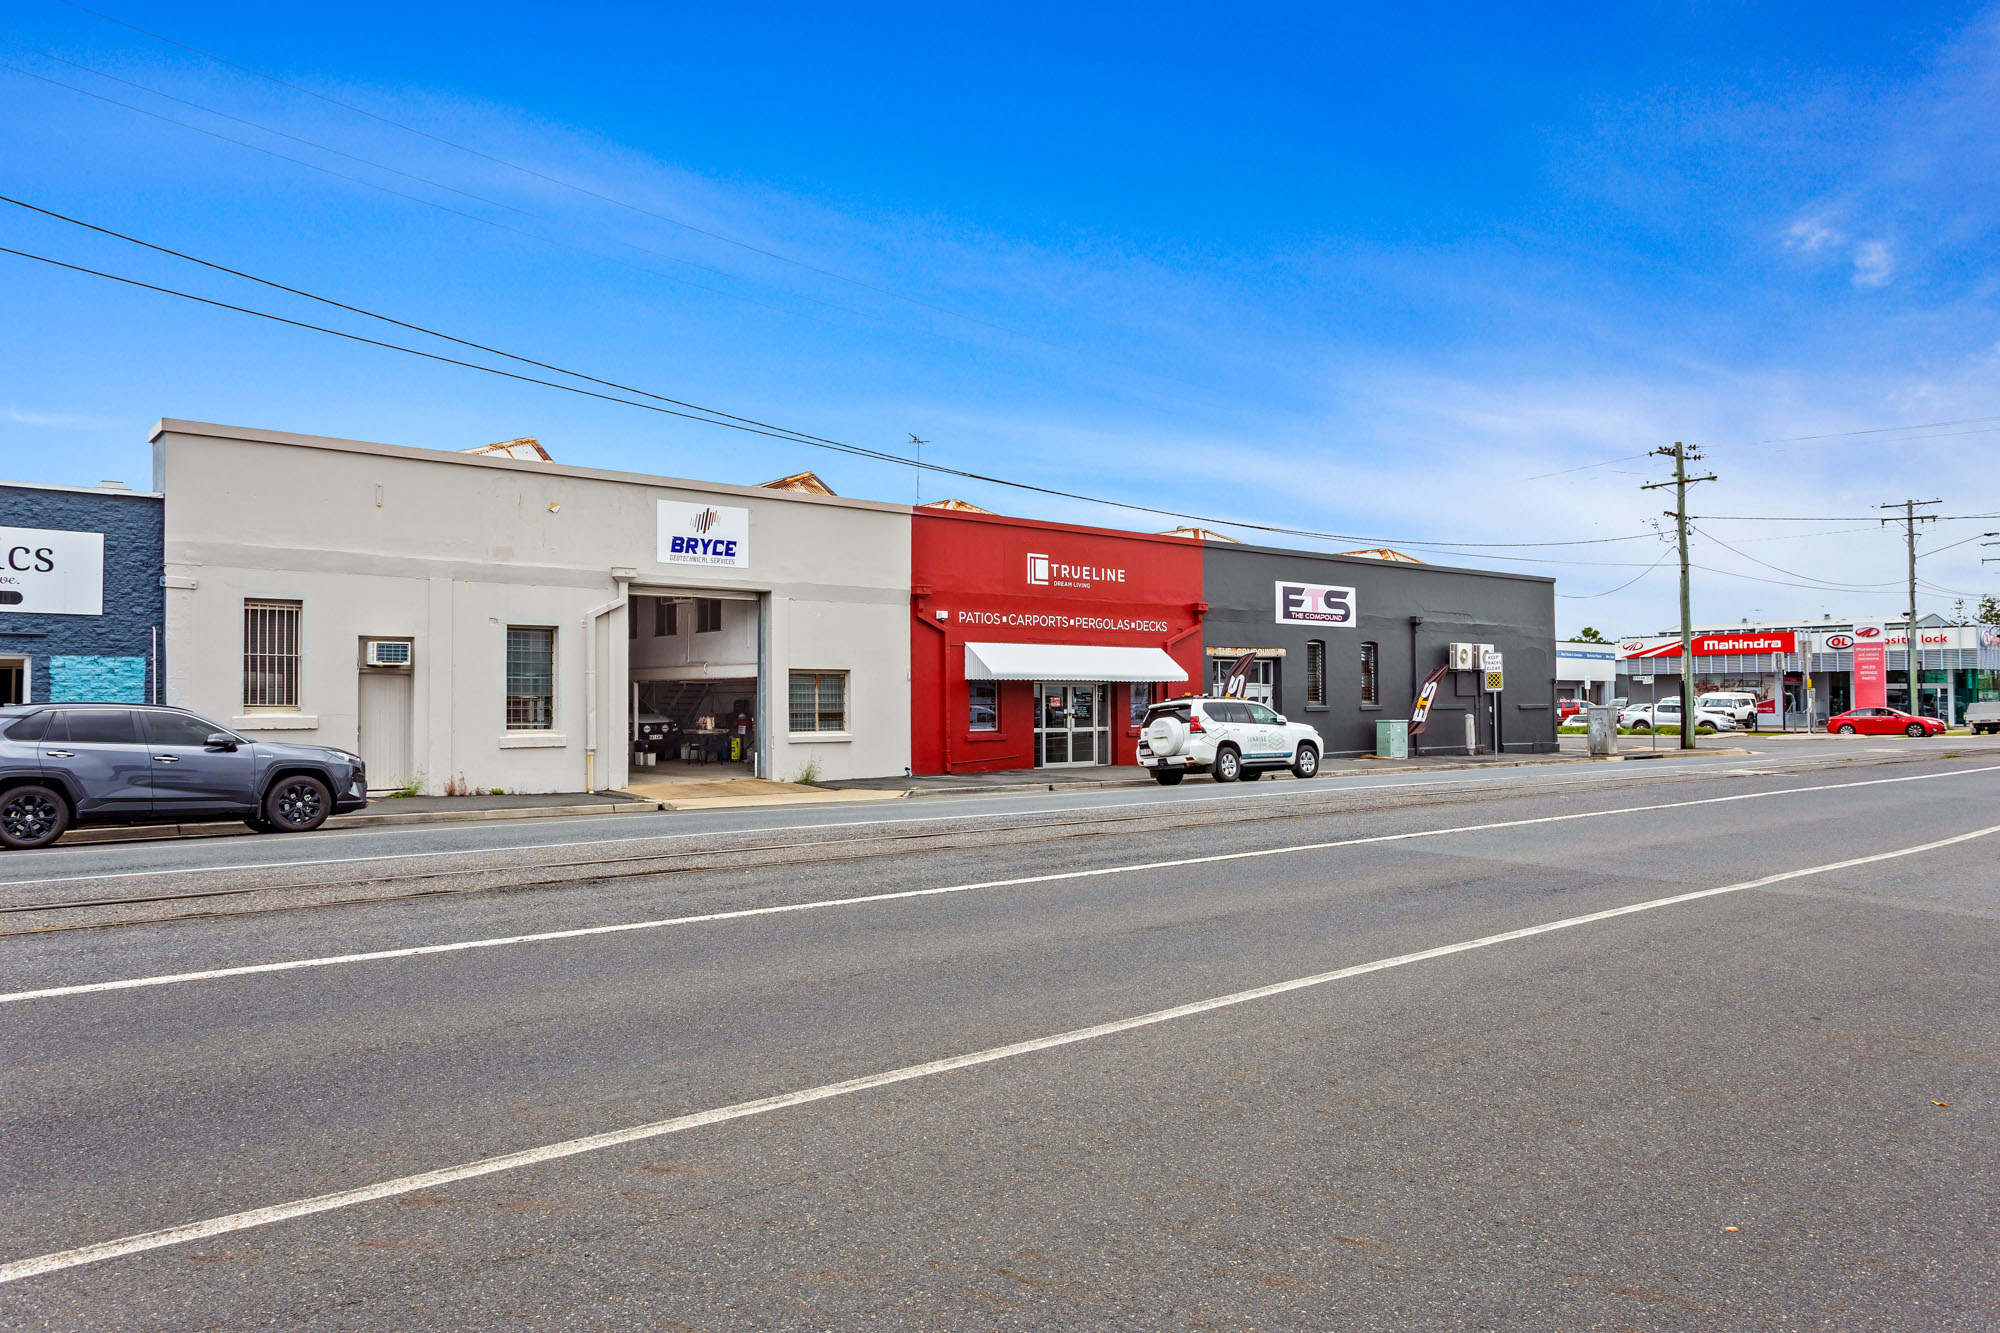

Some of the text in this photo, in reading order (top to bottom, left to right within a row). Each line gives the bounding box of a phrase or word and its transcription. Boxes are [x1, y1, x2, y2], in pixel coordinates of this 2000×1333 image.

[671, 536, 737, 557] BRYCE
[669, 554, 735, 565] GEOTECHNICAL SERVICES
[1051, 563, 1125, 582] TRUELINE
[1053, 580, 1073, 588] DREAM
[1282, 586, 1351, 622] ETS
[958, 611, 1168, 632] PATIOS CARPORTS PERGOLAS DECKS
[1304, 613, 1343, 621] COMPOUND
[1831, 637, 1848, 647] OL
[1921, 633, 1948, 643] lock
